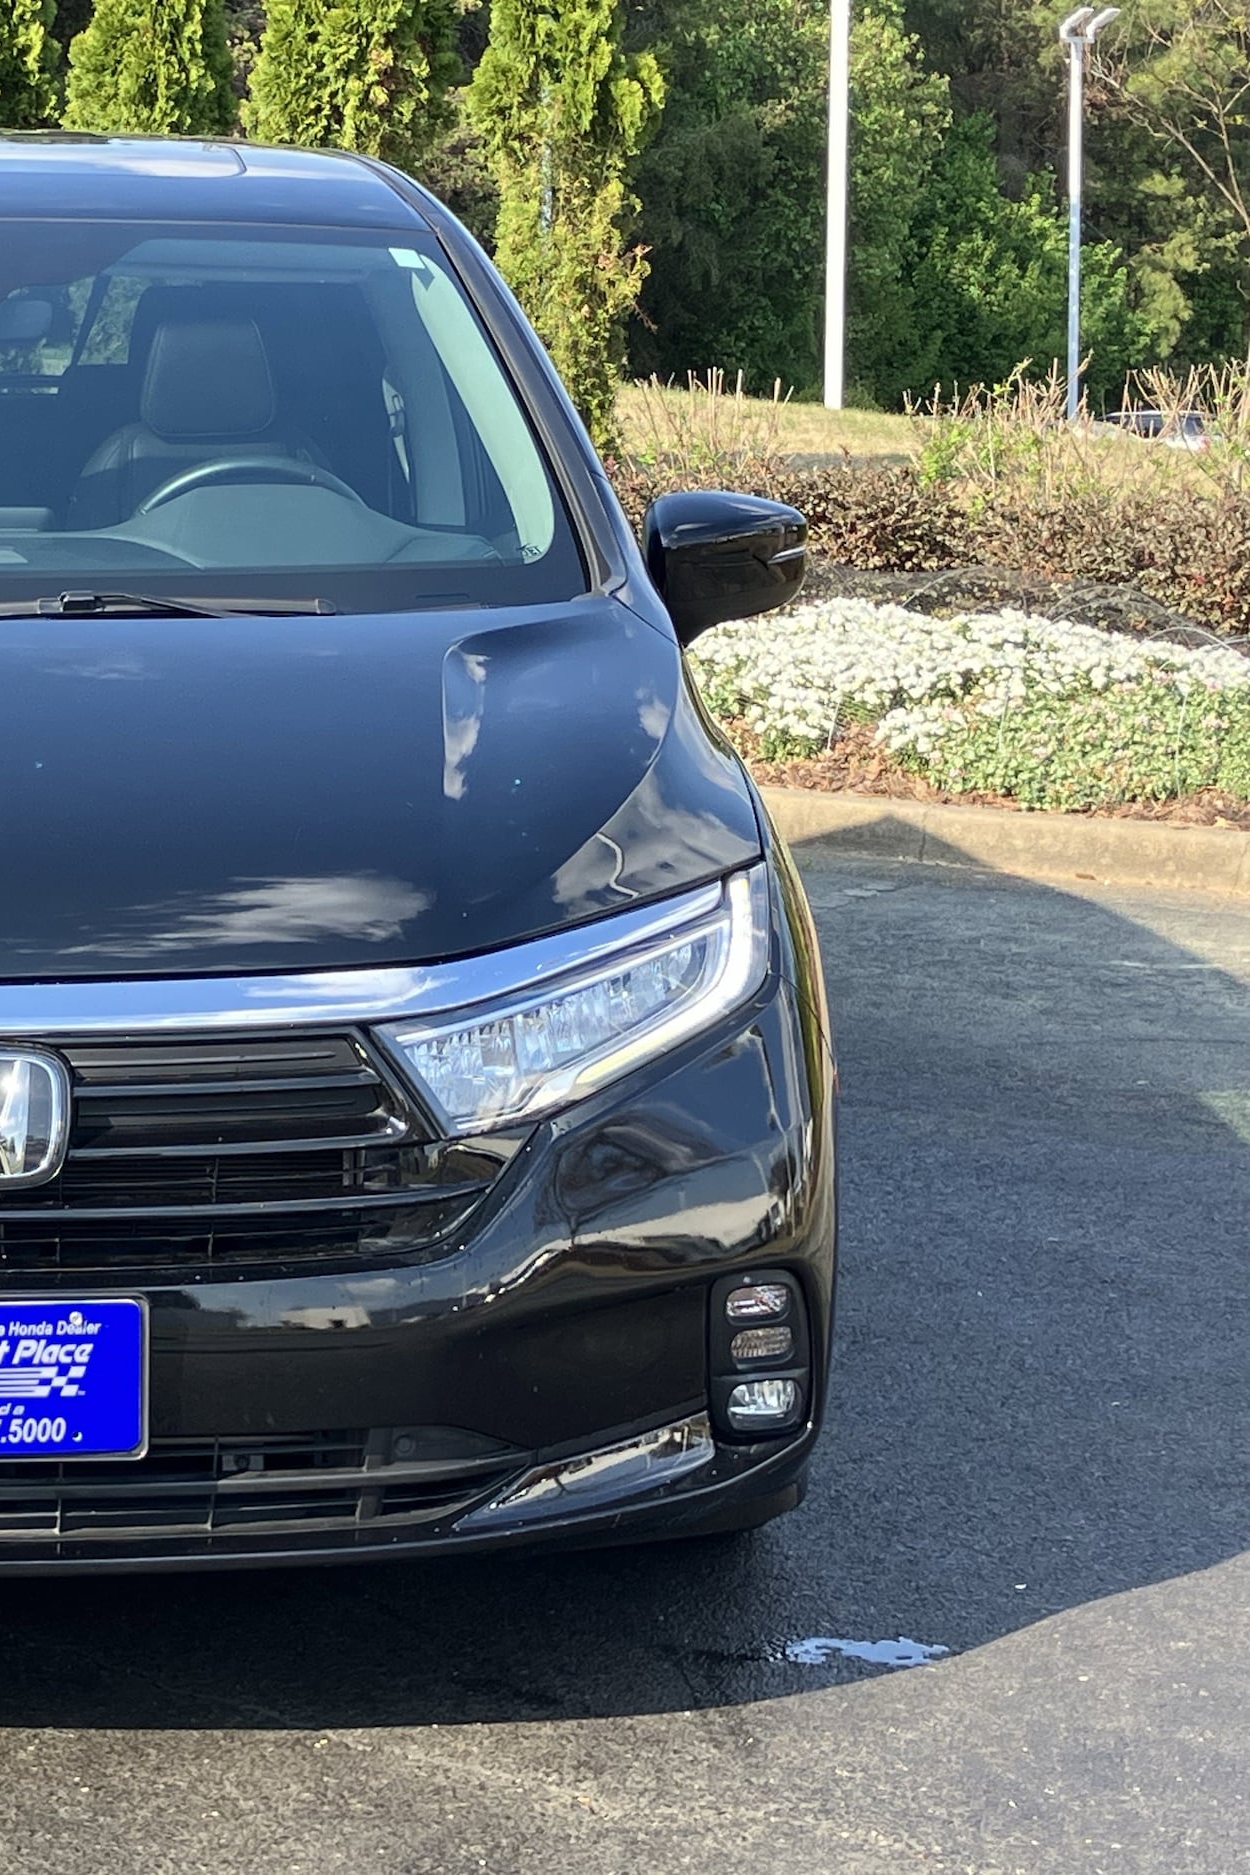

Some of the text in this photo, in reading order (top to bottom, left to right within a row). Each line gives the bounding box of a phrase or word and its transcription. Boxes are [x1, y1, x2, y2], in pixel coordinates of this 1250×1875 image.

[8, 1321, 54, 1336] Honda
[56, 1320, 102, 1335] Dealer
[12, 1339, 94, 1364] Place
